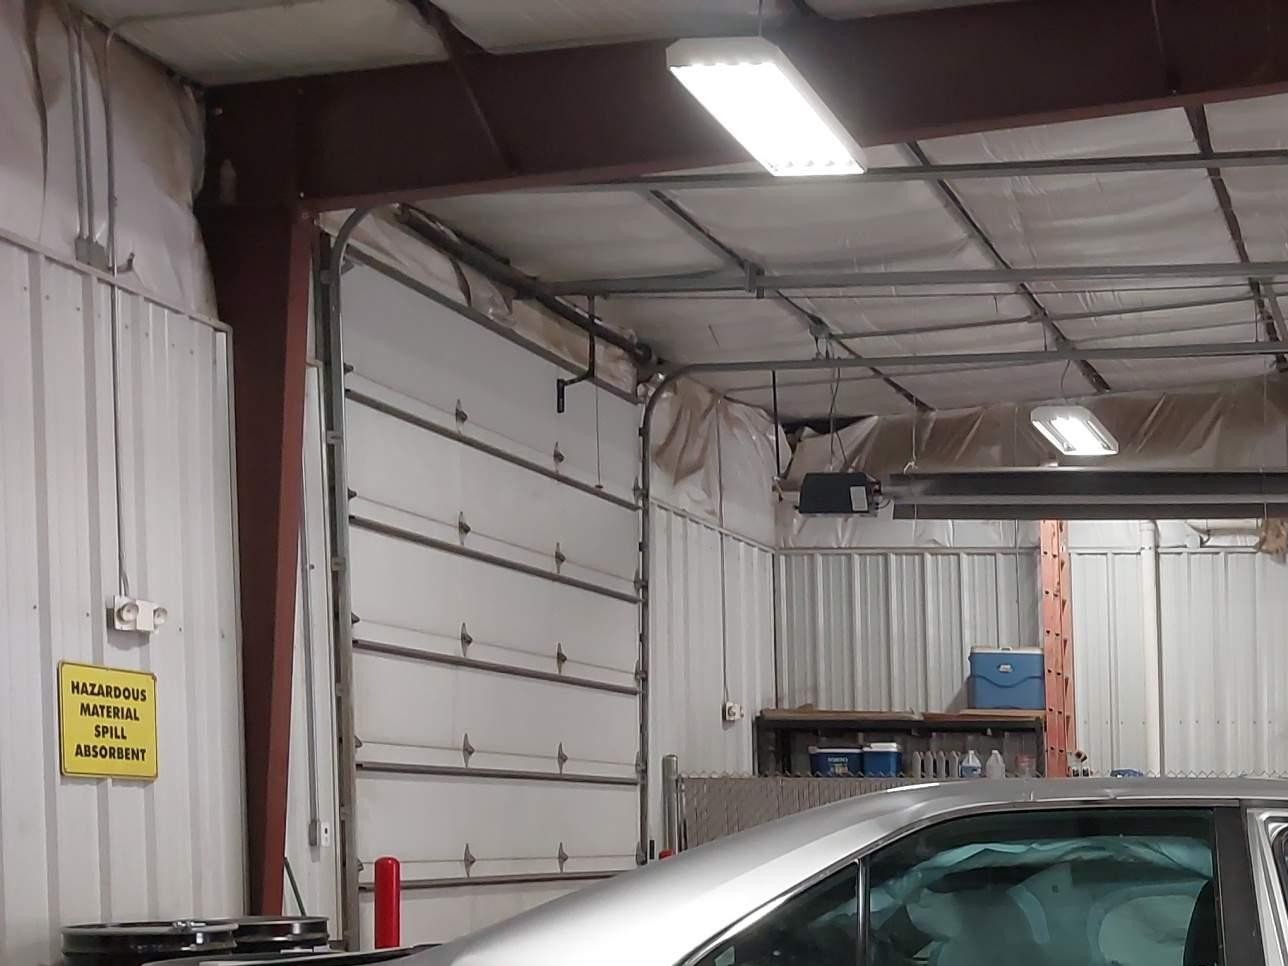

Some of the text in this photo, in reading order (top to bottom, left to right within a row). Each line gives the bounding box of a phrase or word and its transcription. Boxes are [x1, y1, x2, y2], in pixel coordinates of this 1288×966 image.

[71, 680, 147, 702] HAZARDOUS
[80, 703, 140, 721] MATERIAL
[94, 724, 127, 740] SPILL
[75, 744, 147, 761] ABSORBENT
